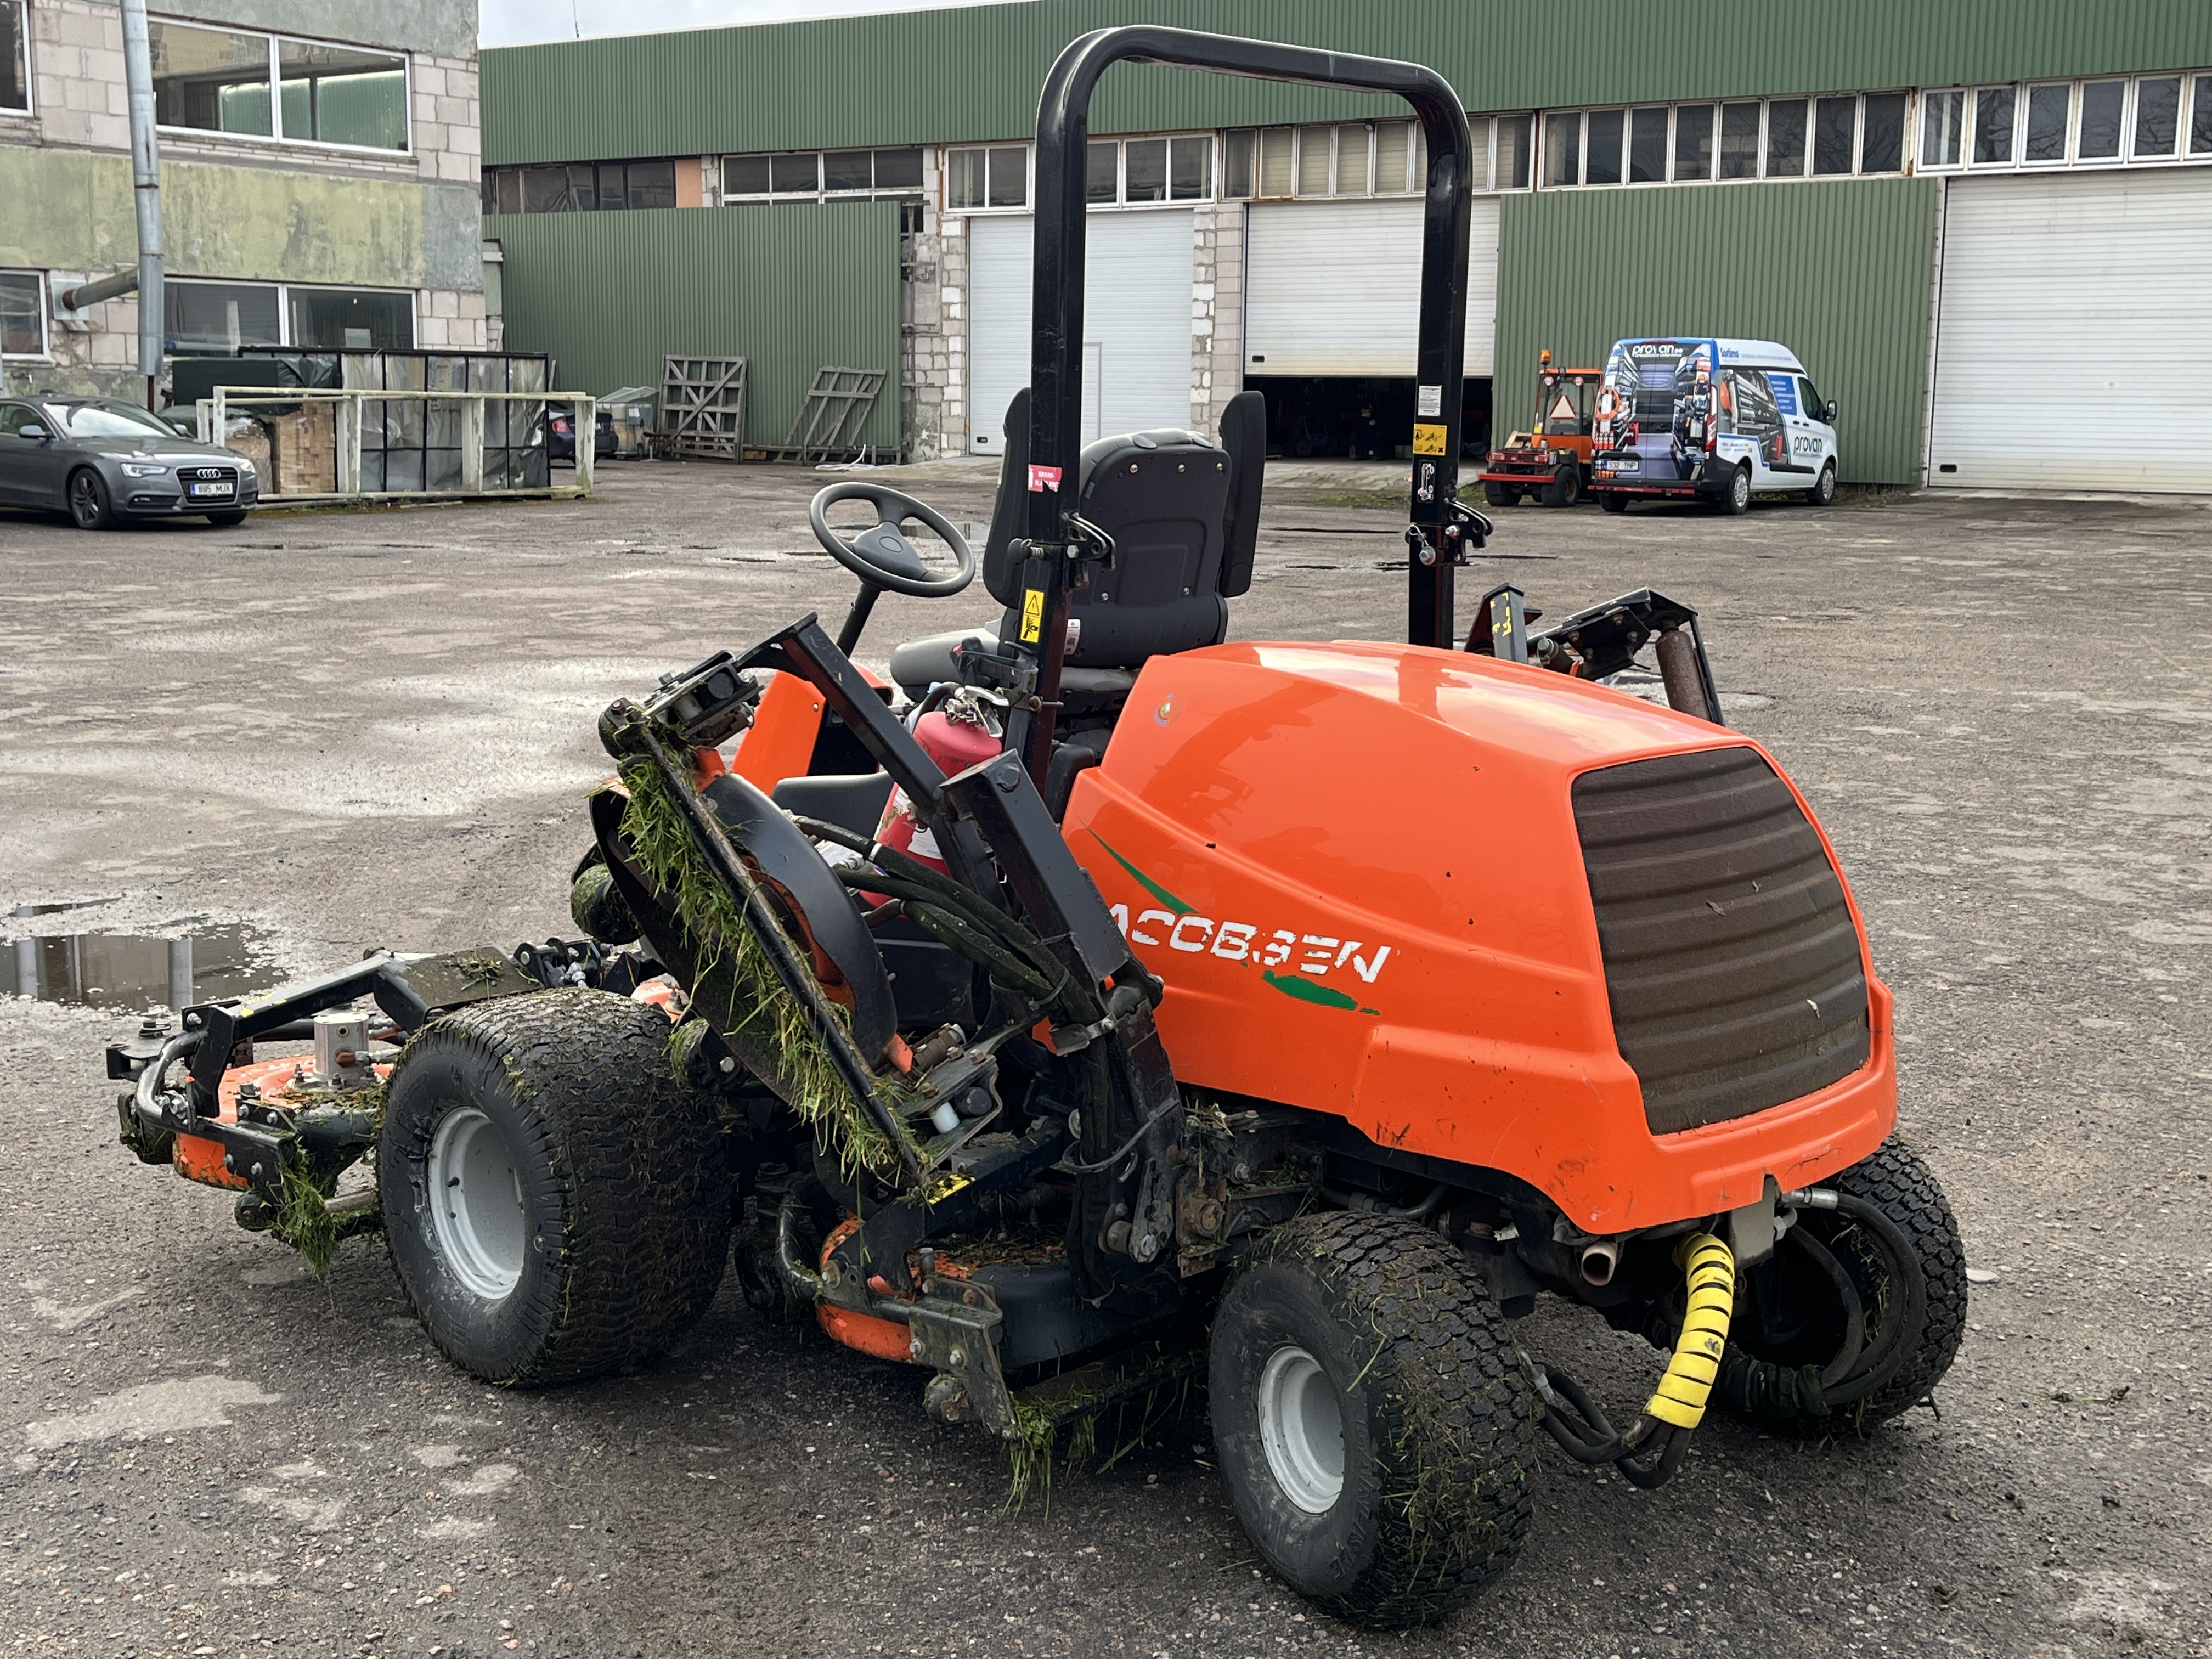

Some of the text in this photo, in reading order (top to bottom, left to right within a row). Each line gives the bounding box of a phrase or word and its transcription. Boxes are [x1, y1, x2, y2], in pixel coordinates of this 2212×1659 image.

[1793, 436, 1822, 455] provan
[216, 483, 230, 493] MJX
[1109, 903, 1392, 984] ACOBSEN
